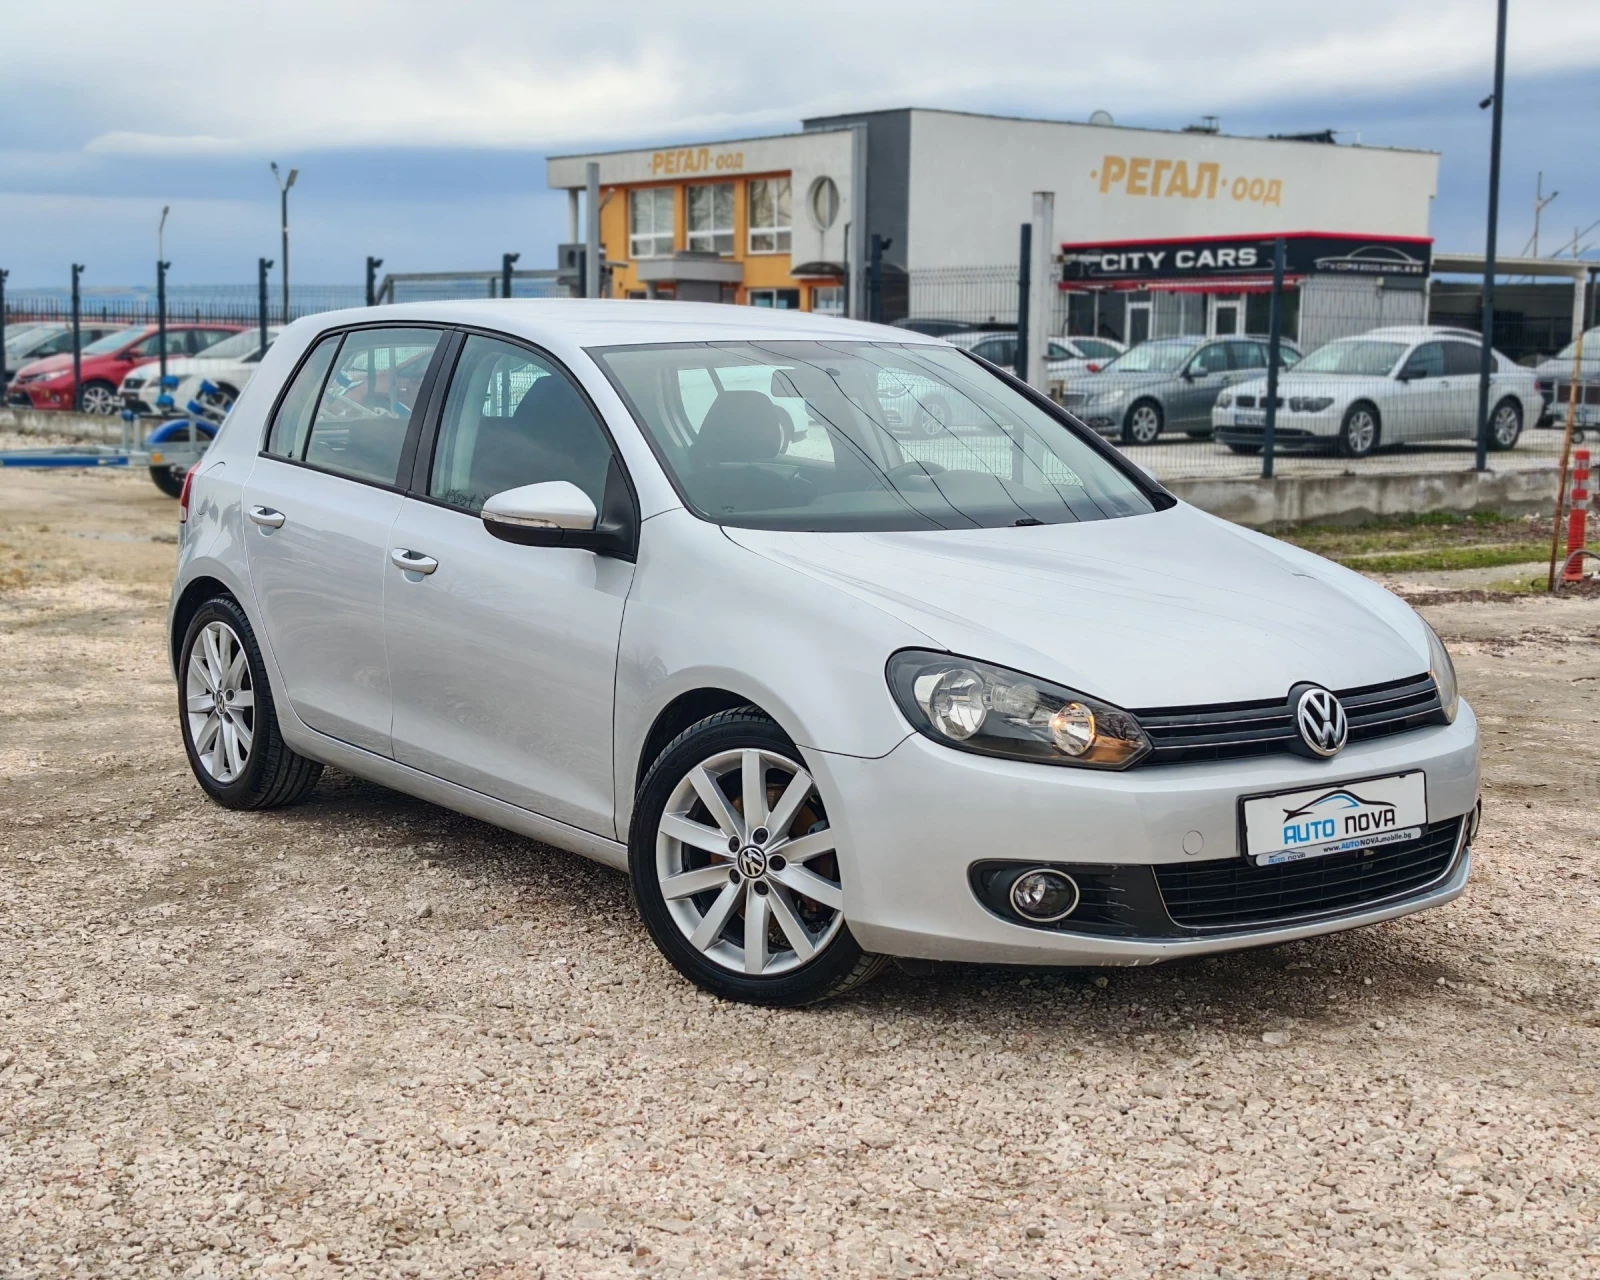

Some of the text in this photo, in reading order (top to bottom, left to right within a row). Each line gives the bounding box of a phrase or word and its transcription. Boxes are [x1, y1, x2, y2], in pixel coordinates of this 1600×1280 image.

[1100, 247, 1258, 271] CITY CARS
[1283, 808, 1396, 845] AUTO NOVA
